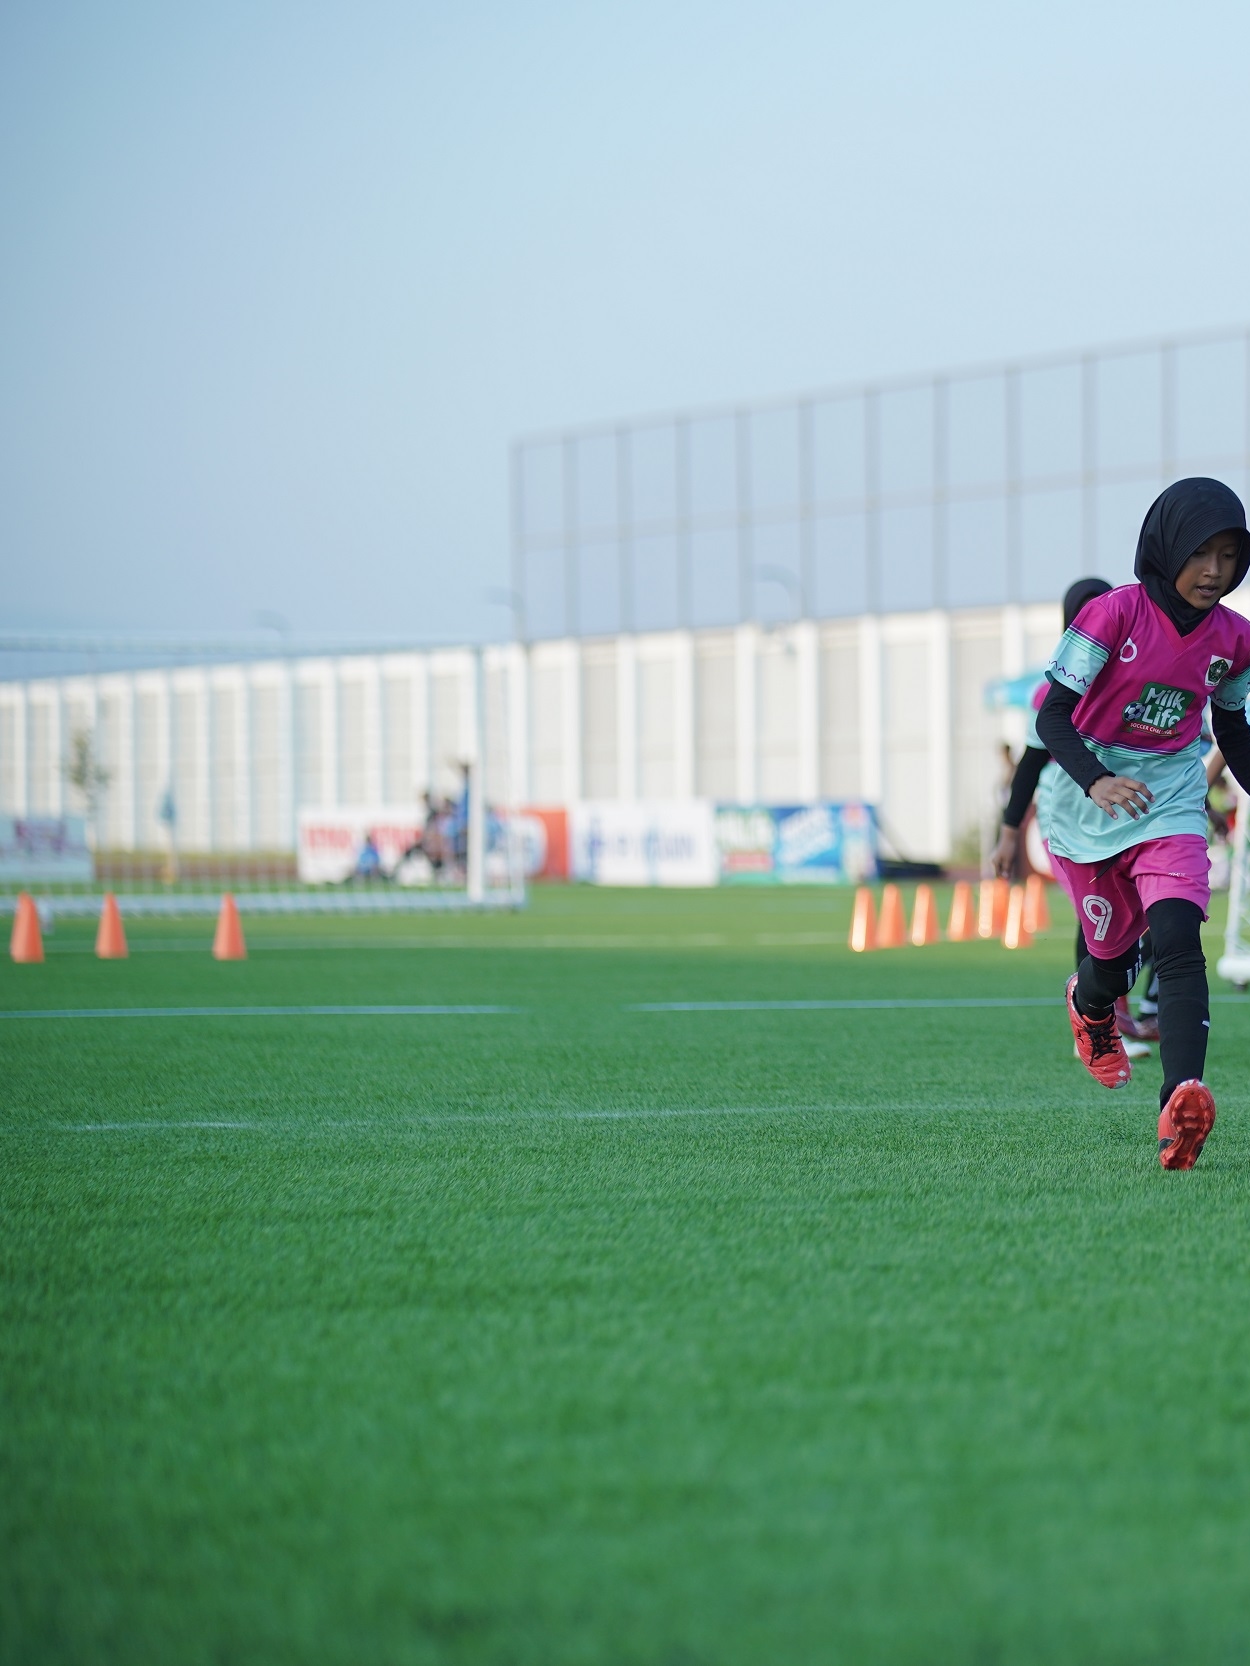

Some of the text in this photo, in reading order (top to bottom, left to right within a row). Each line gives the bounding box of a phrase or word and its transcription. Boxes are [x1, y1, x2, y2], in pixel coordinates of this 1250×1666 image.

[1144, 687, 1186, 711] Milk
[1130, 722, 1149, 731] SOCCER
[1082, 894, 1113, 942] 9
